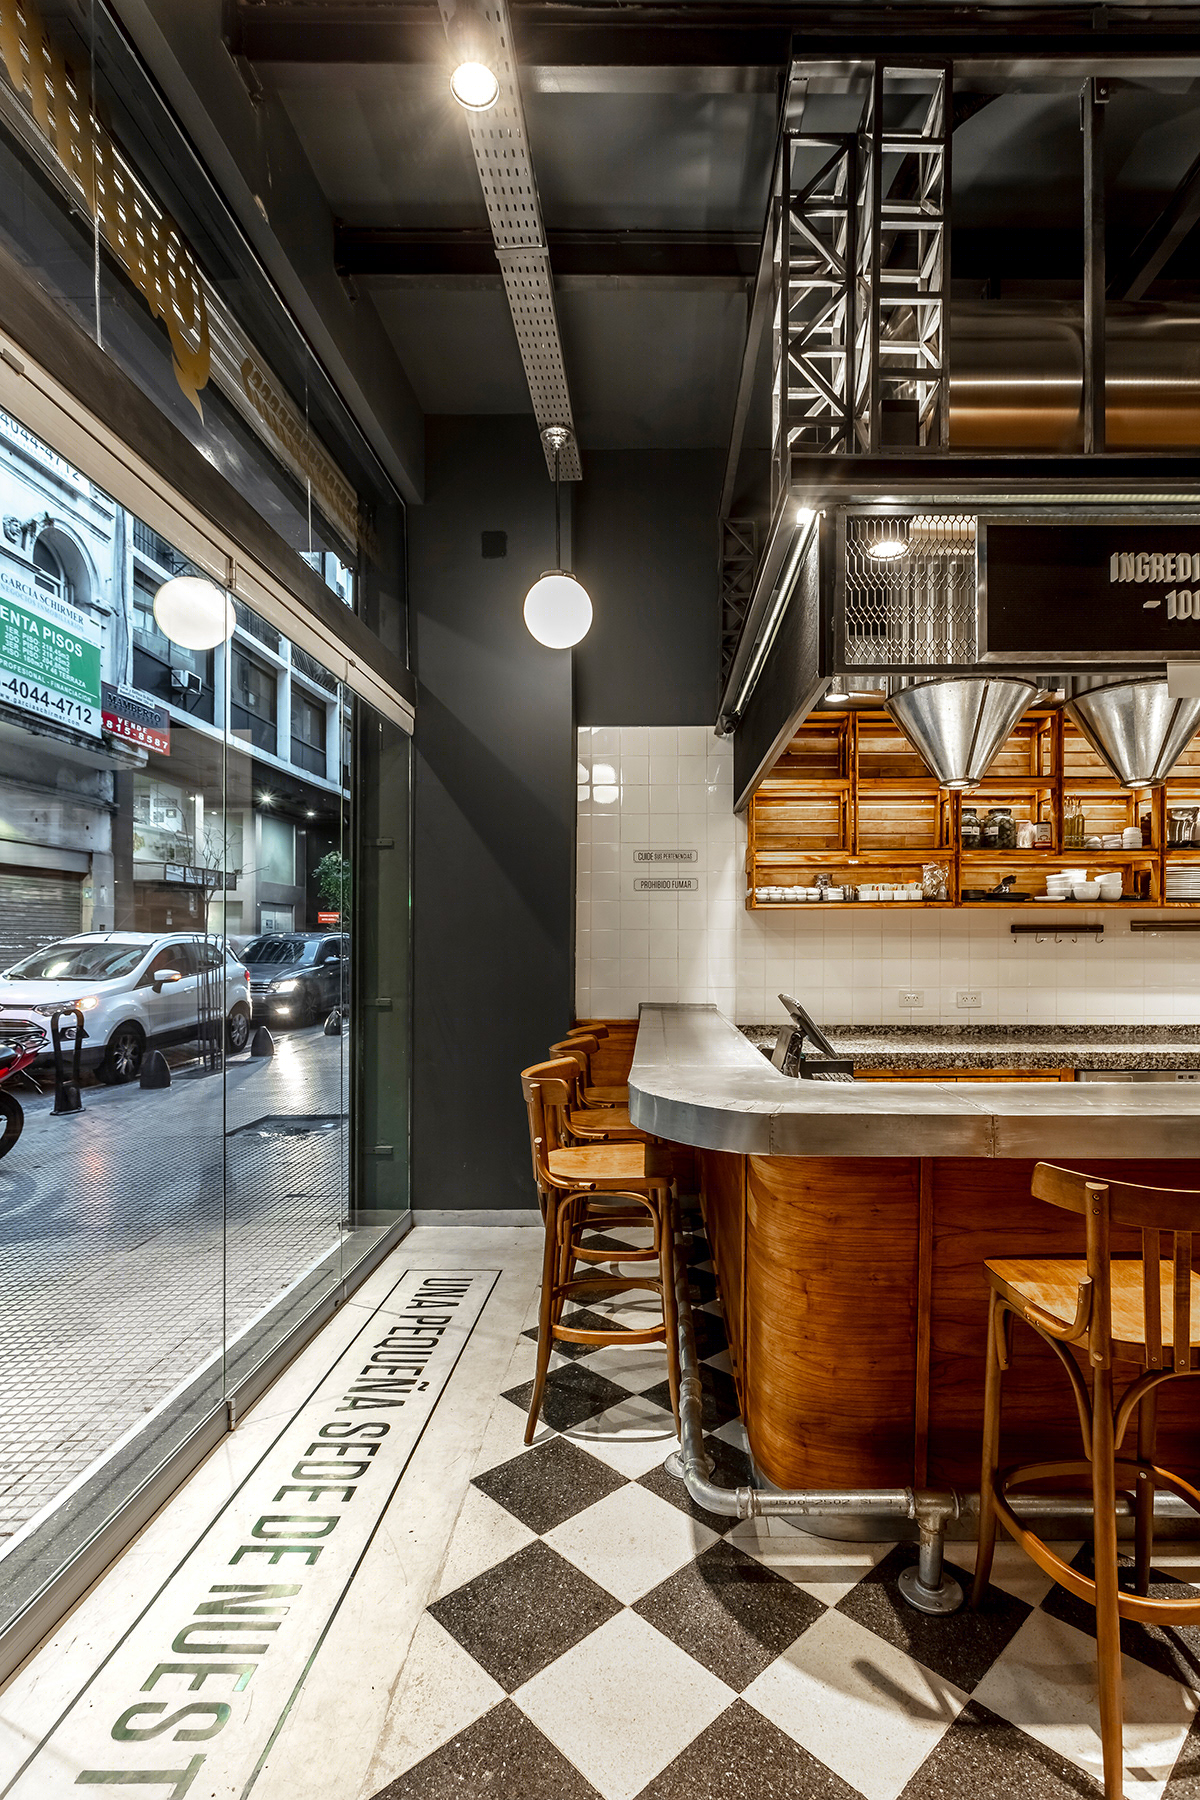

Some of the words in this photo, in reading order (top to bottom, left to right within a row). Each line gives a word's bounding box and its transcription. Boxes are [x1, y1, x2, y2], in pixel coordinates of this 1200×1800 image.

[1, 573, 38, 600] GARCIA
[40, 593, 84, 625] SCHIRMER
[43, 626, 83, 657] PISOS
[51, 680, 92, 703] FINANCIACION
[59, 671, 86, 688] TERRAZA
[107, 692, 161, 722] MAMBERTO
[117, 717, 147, 734] VENDE
[638, 852, 653, 861] CUIDE
[640, 880, 670, 889] PROHIBIDO
[671, 880, 692, 889] FUMAR
[405, 1278, 473, 1309] UNA
[334, 1315, 452, 1412] PEQUEÑA
[273, 1422, 391, 1502] SEDE
[228, 1516, 341, 1565] DE
[74, 1584, 303, 1800] NUEST
